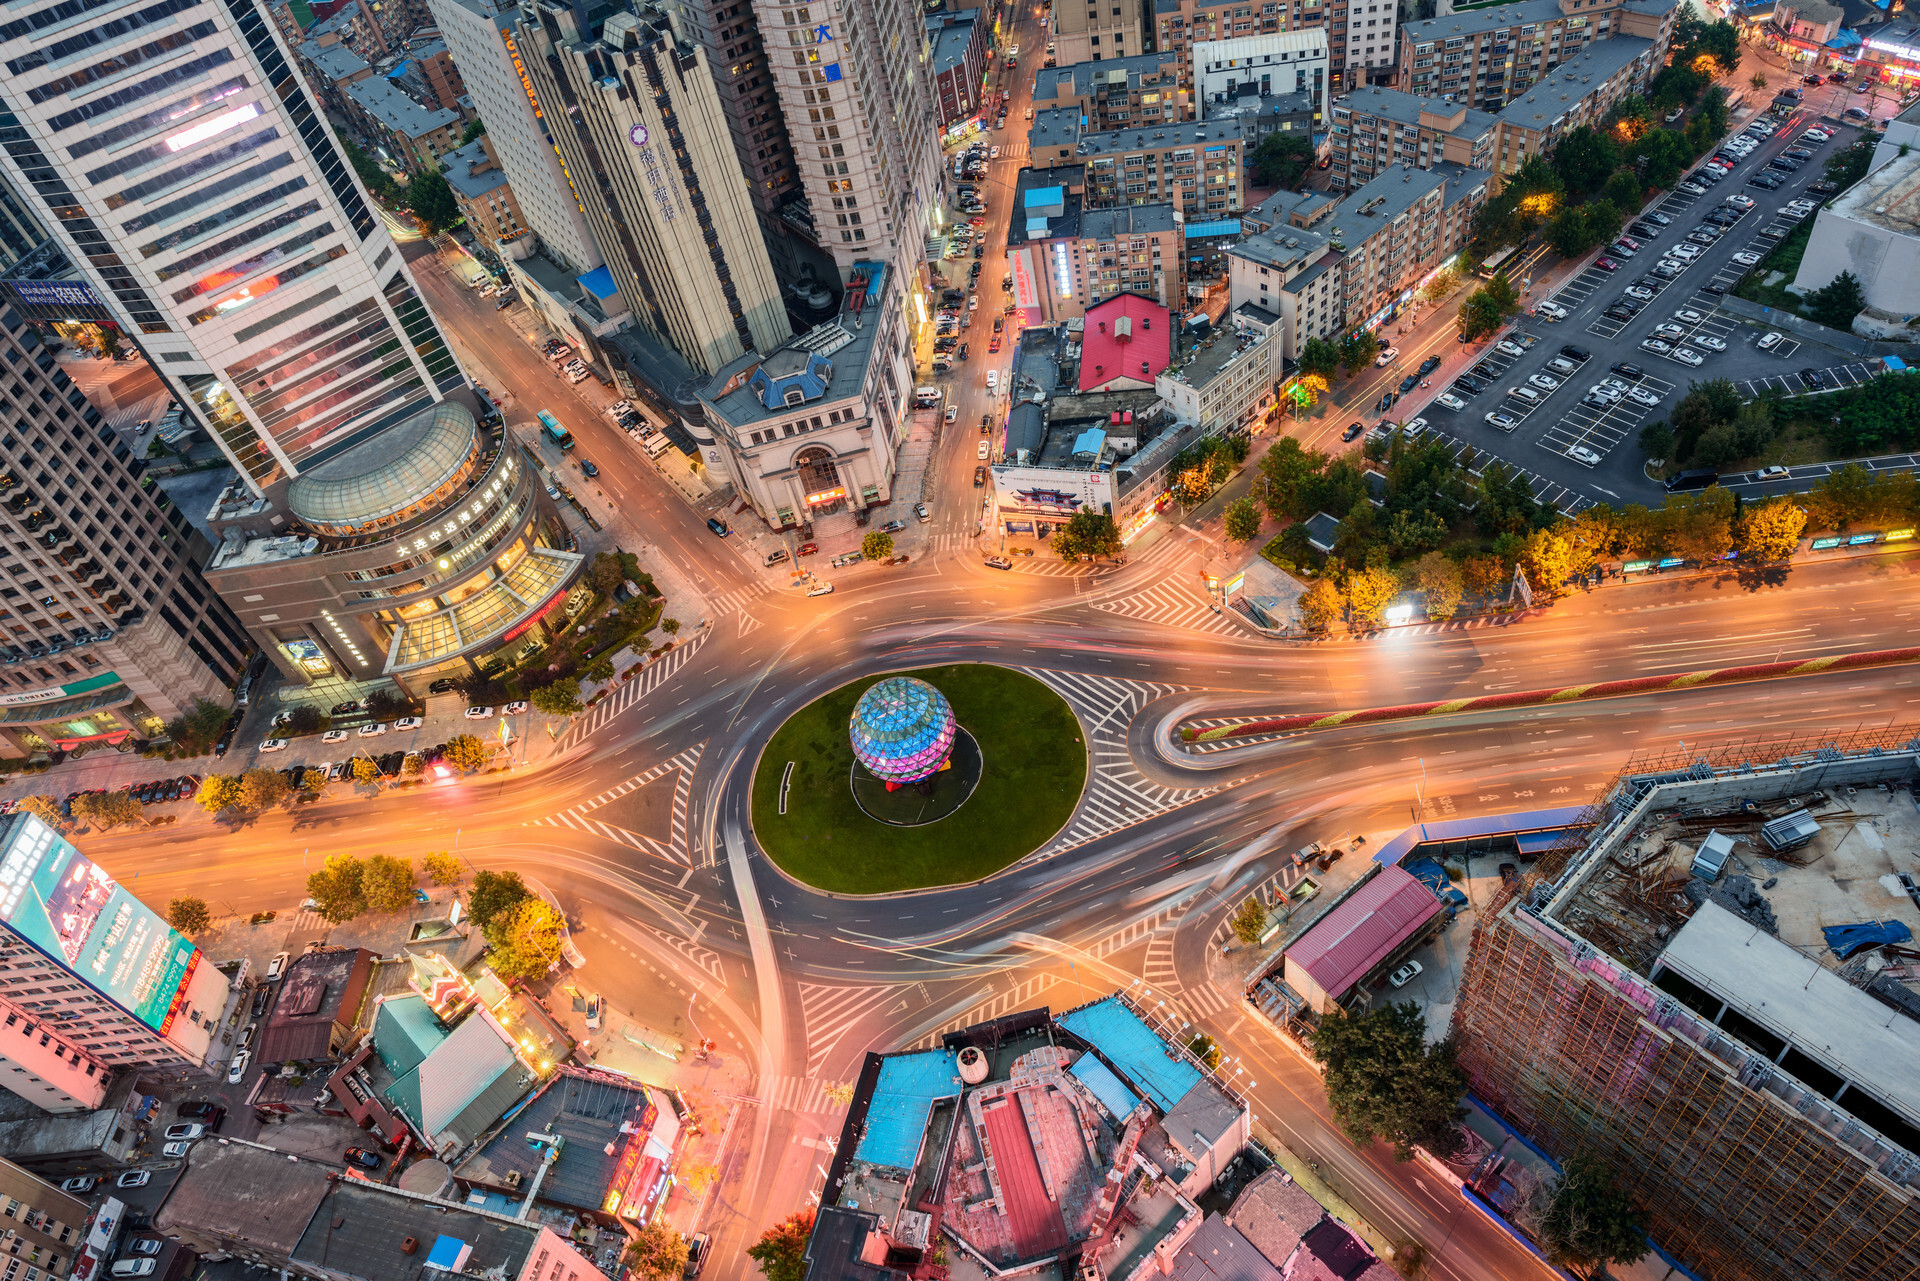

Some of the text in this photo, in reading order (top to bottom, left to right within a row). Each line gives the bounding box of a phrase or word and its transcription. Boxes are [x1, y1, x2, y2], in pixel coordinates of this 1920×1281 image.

[397, 456, 513, 557] 大连中远海运洲际酒店
[451, 503, 517, 562] INTERCONTINENTAL
[149, 934, 164, 960] 9999
[158, 984, 170, 1004] 8474
[167, 963, 179, 983] 9999
